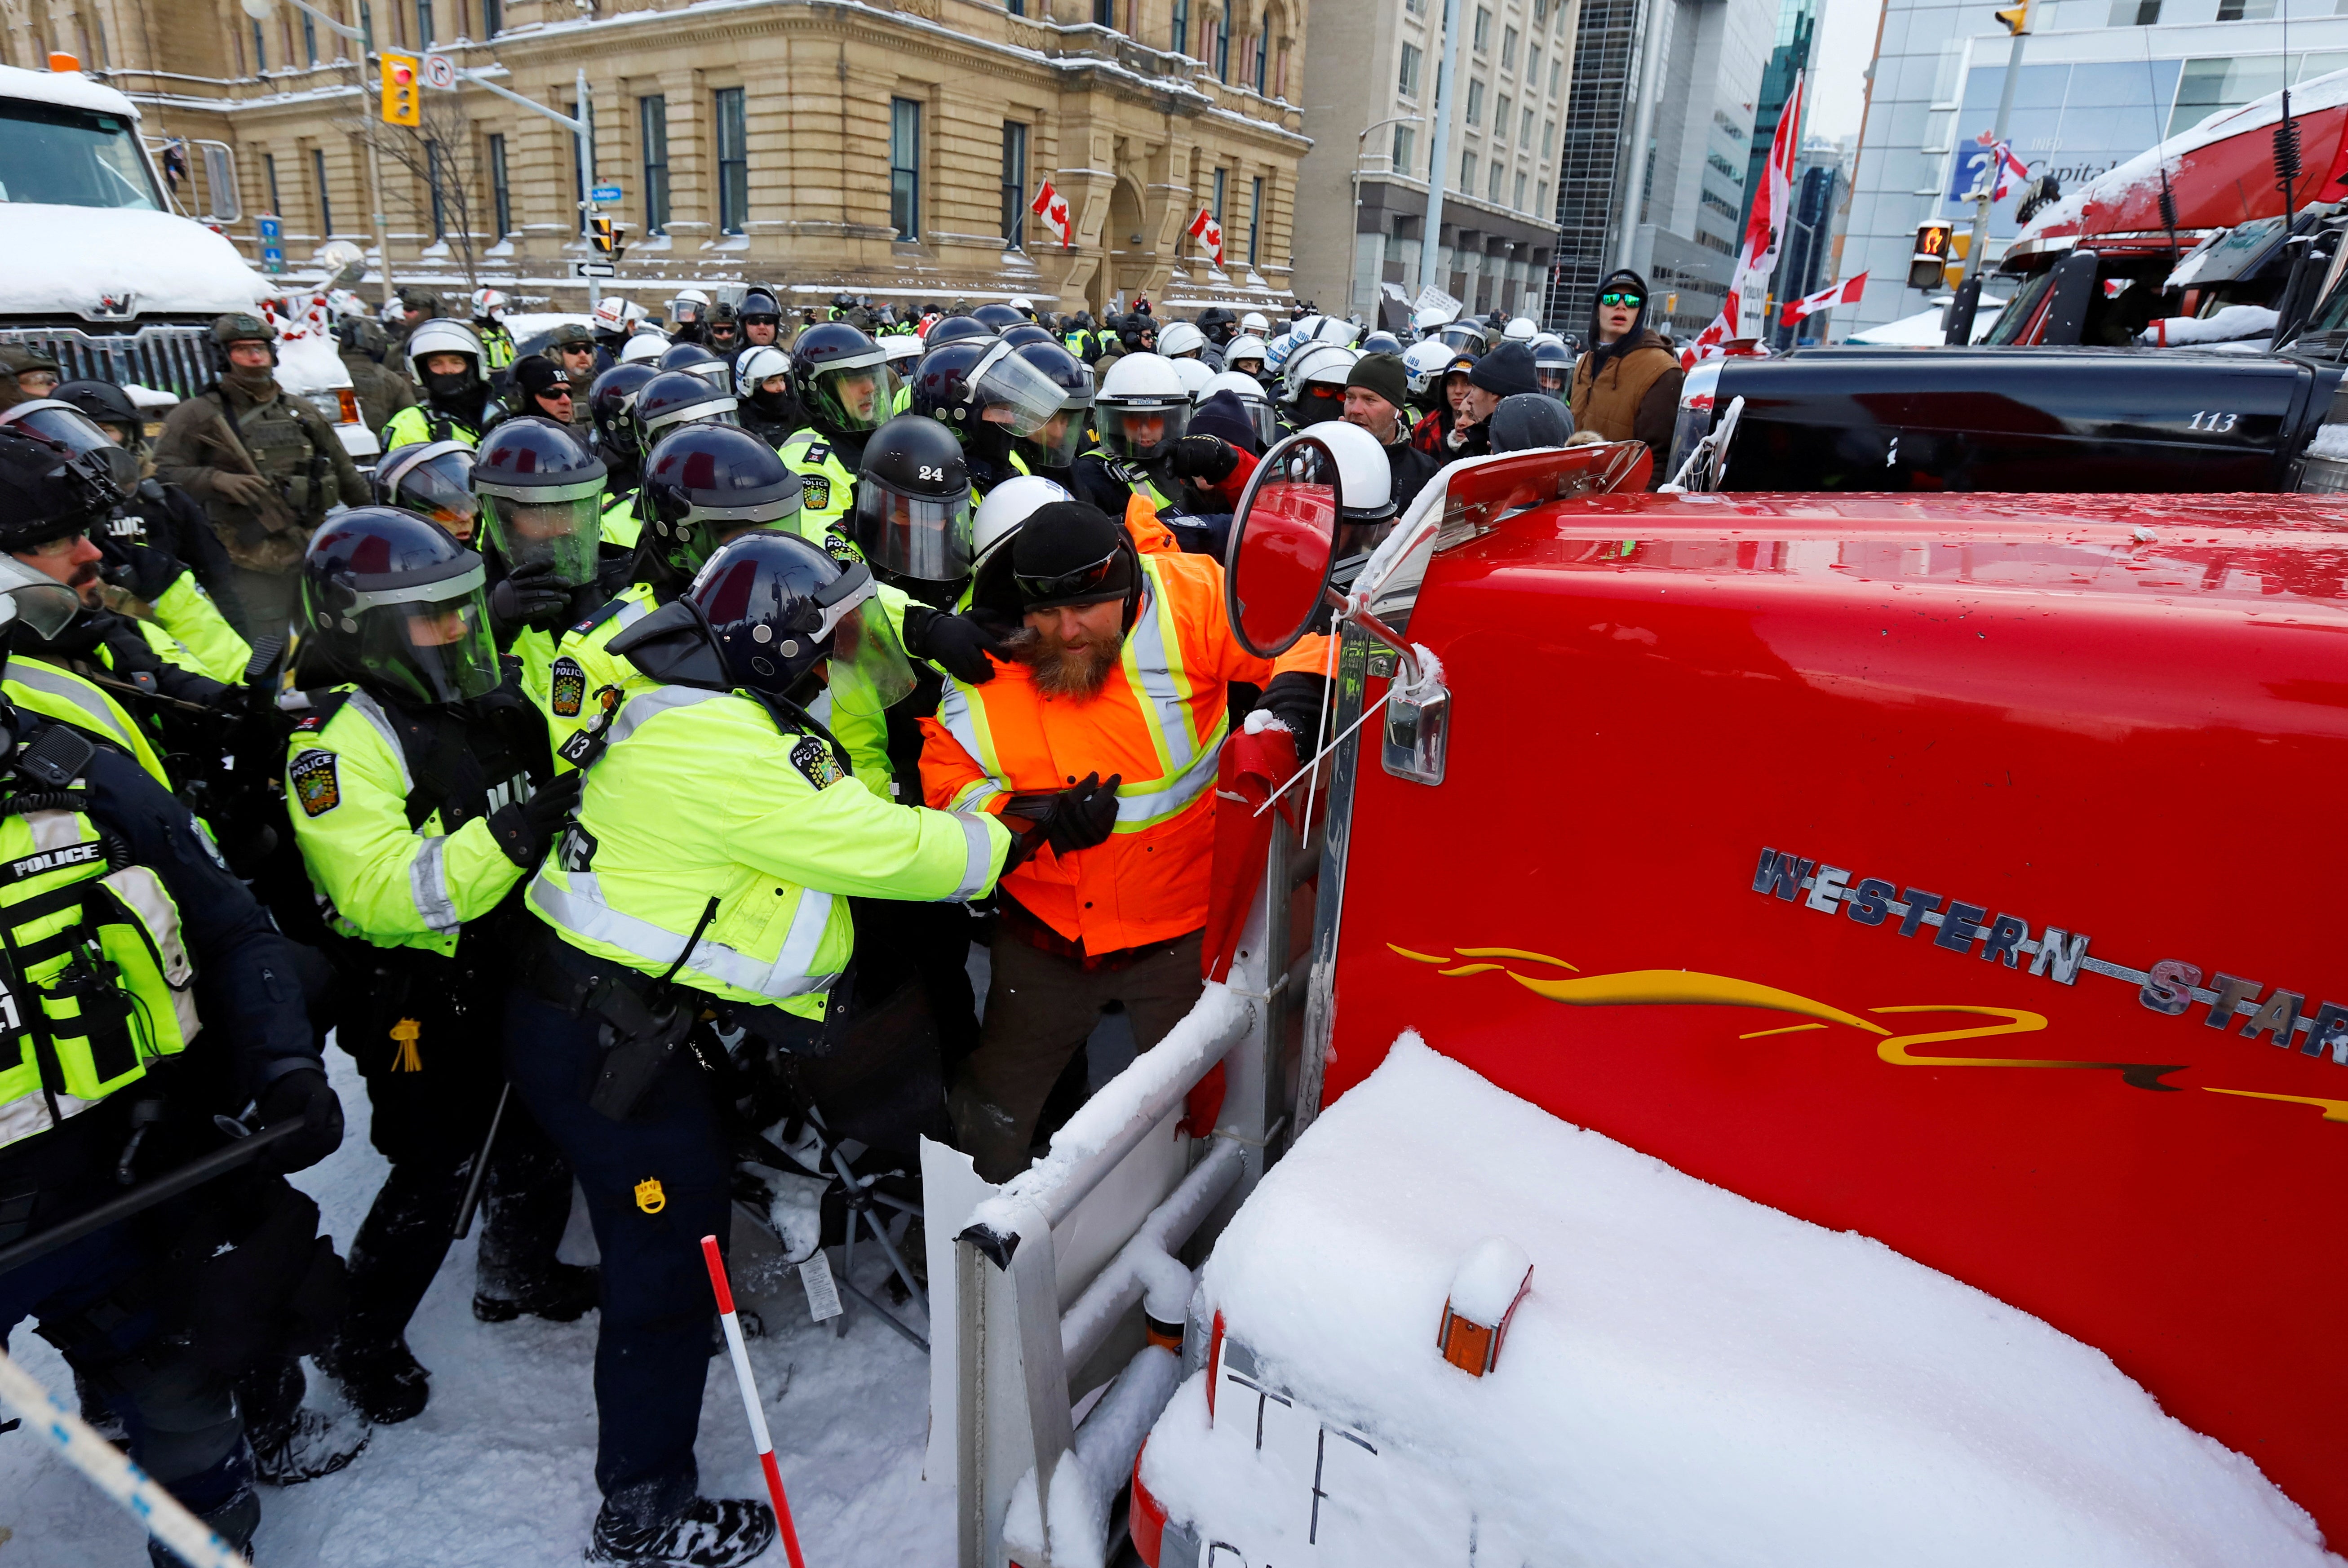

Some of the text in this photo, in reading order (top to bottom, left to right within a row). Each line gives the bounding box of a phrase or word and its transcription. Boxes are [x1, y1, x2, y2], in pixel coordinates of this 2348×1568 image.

[2032, 137, 2063, 152] INFO
[2023, 159, 2117, 184] Capital
[1296, 331, 1310, 342] 096
[1407, 355, 1420, 367] 089
[2187, 410, 2238, 433] 113
[918, 465, 944, 482] 24
[555, 667, 584, 678] POLICE
[793, 747, 807, 758] PEEL
[292, 755, 332, 779] POLICE
[13, 844, 100, 877] POLICE
[1751, 846, 2348, 1067] WESTERN STAR
